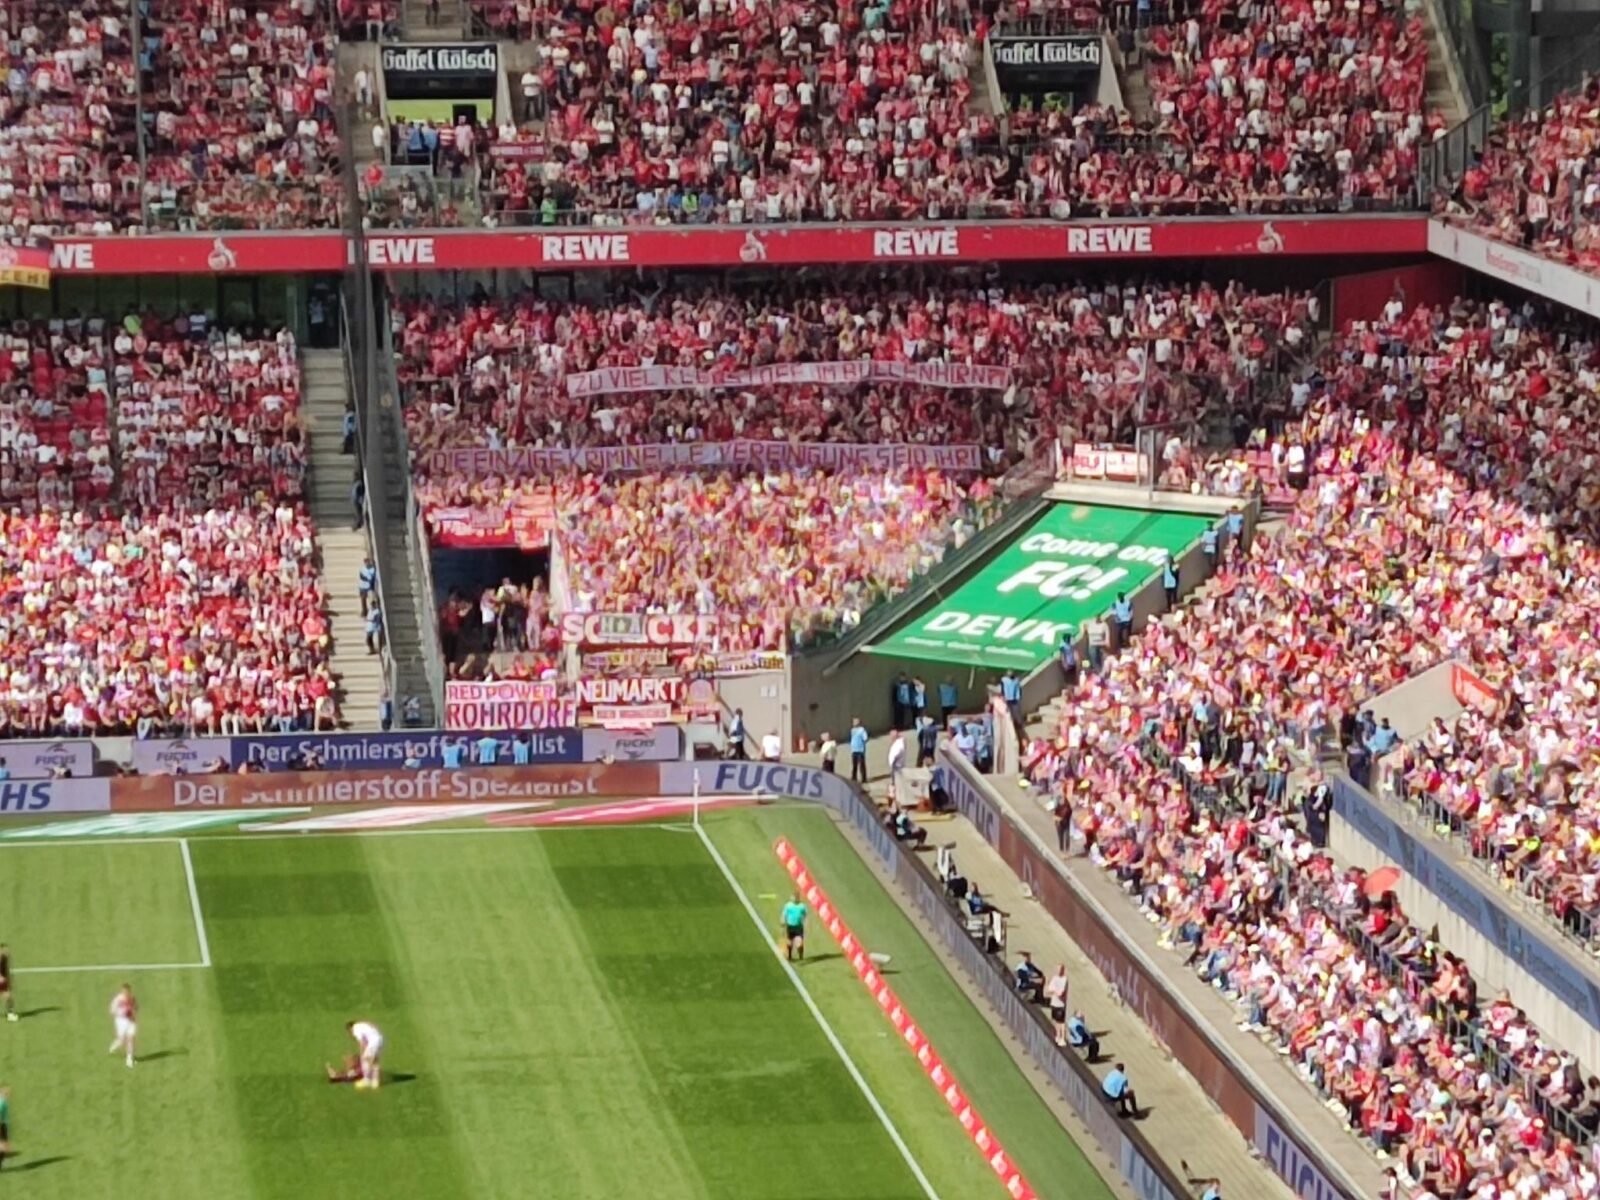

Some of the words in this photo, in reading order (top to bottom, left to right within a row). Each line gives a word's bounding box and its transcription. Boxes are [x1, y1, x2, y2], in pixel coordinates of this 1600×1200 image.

[383, 49, 434, 71] Gaffel
[542, 235, 630, 261] REWE
[874, 230, 959, 256] REWE
[1067, 228, 1152, 252] REWE
[49, 243, 94, 269] WE
[608, 368, 657, 389] VIEL
[1020, 532, 1119, 558] Come
[997, 560, 1129, 600] FC!
[923, 611, 1074, 645] DEVK
[448, 684, 482, 700] RED
[485, 683, 557, 702] POWER
[575, 677, 683, 703] NEUMARKT
[446, 699, 576, 729] ROHRDORF
[248, 740, 291, 763] Der
[173, 780, 225, 807] Der
[714, 762, 824, 799] FUCHS
